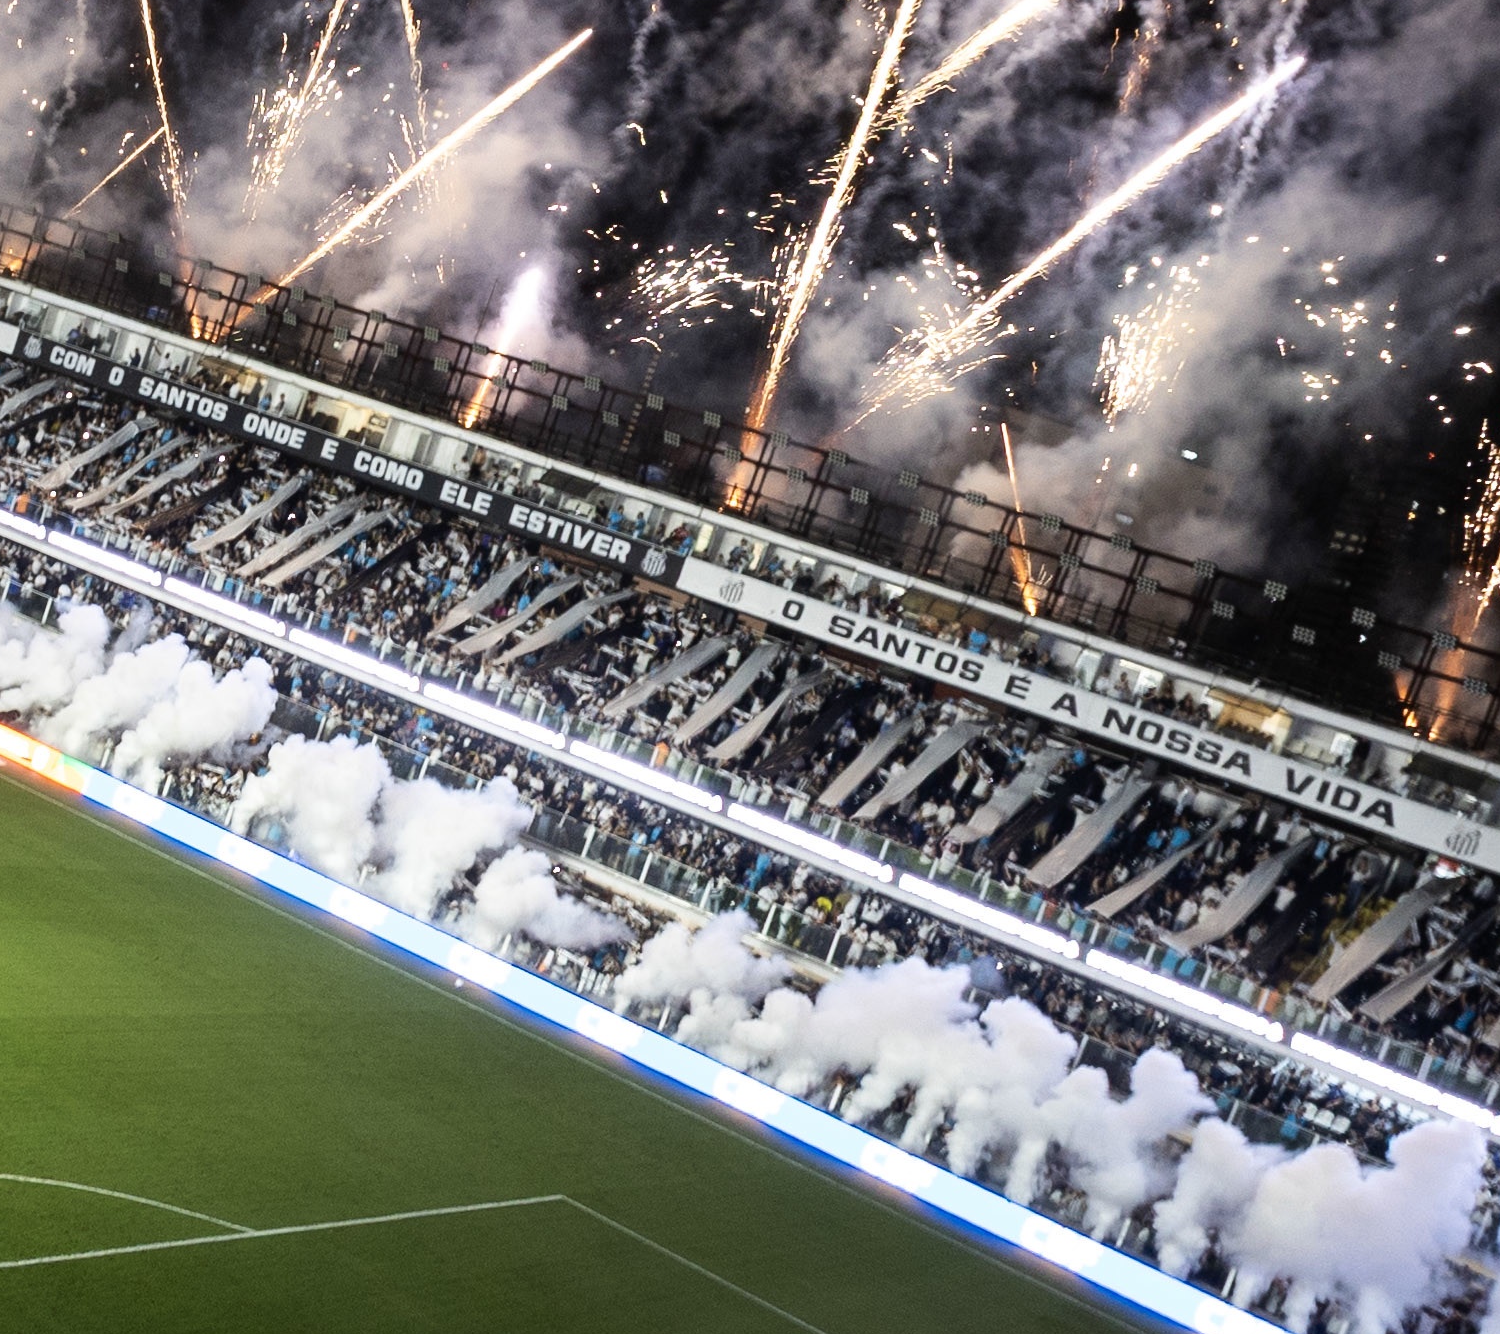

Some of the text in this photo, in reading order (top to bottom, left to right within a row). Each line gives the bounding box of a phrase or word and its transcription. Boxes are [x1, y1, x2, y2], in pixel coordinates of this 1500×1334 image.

[50, 346, 631, 564] COM O SANTOS ONDE E COMO ELE ESTIVER
[782, 599, 1395, 827] O SANTOS É A NOSSA VIDA
